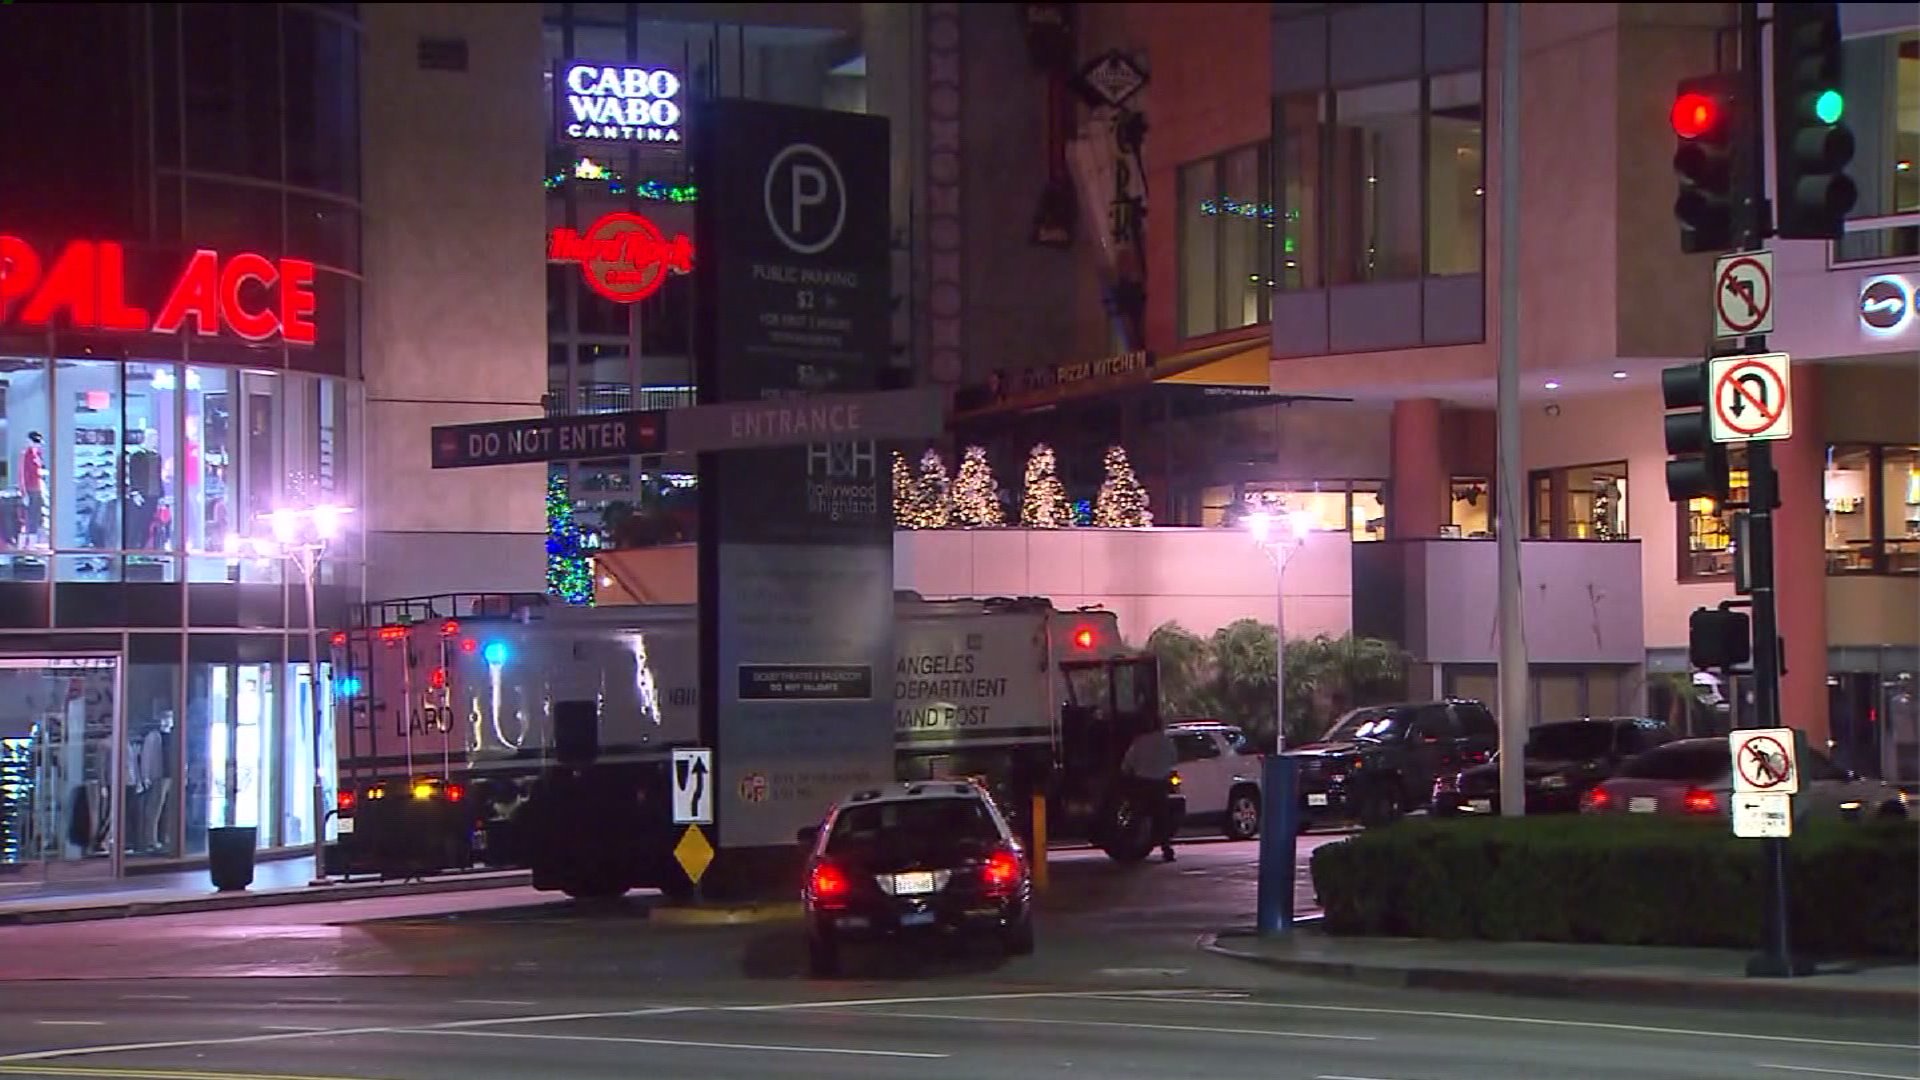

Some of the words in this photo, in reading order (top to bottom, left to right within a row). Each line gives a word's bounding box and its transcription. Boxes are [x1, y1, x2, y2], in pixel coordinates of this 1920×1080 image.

[568, 65, 680, 98] CABO
[568, 95, 680, 126] WABO
[567, 123, 680, 142] CANTINA
[0, 234, 317, 345] PALACE
[1094, 350, 1147, 377] KITCHEN
[731, 404, 861, 438] ENTRANCE
[468, 432, 500, 457] DO
[508, 427, 555, 454] NOT
[559, 421, 627, 451] ENTER
[808, 480, 876, 499] hollywood
[896, 654, 974, 675] ANGELES
[895, 678, 1007, 699] DEPARTMENT
[396, 706, 455, 738] LAPD
[945, 706, 989, 727] POST
